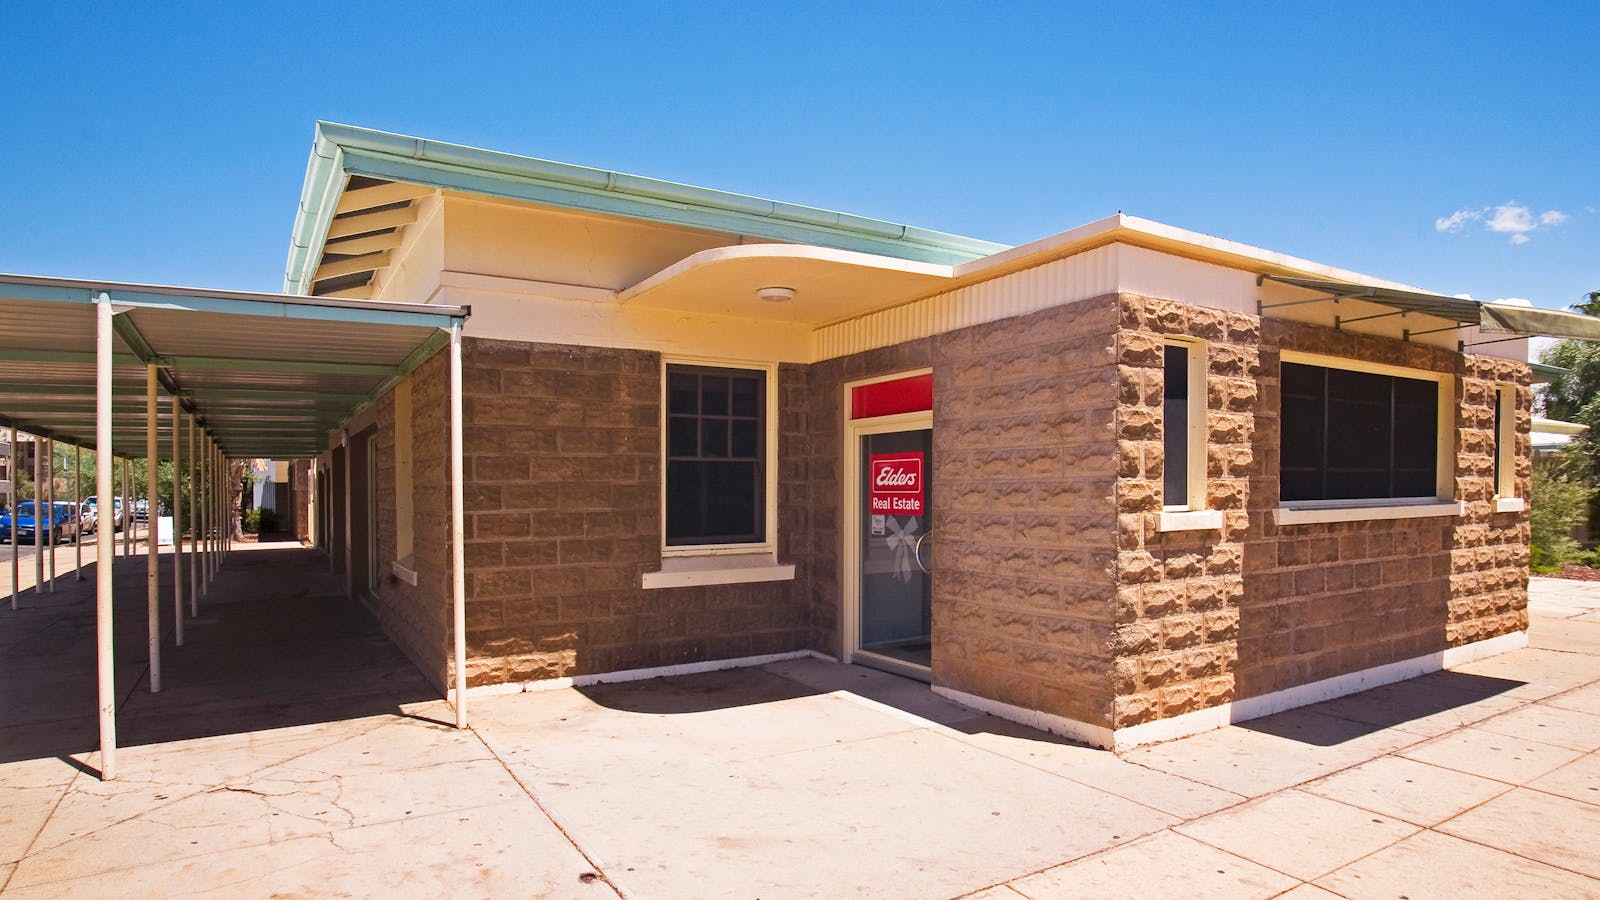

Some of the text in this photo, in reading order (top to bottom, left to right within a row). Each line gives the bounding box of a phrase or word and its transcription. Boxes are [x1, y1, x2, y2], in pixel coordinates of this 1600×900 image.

[876, 466, 917, 486] Elders
[872, 497, 920, 510] Real Estate
